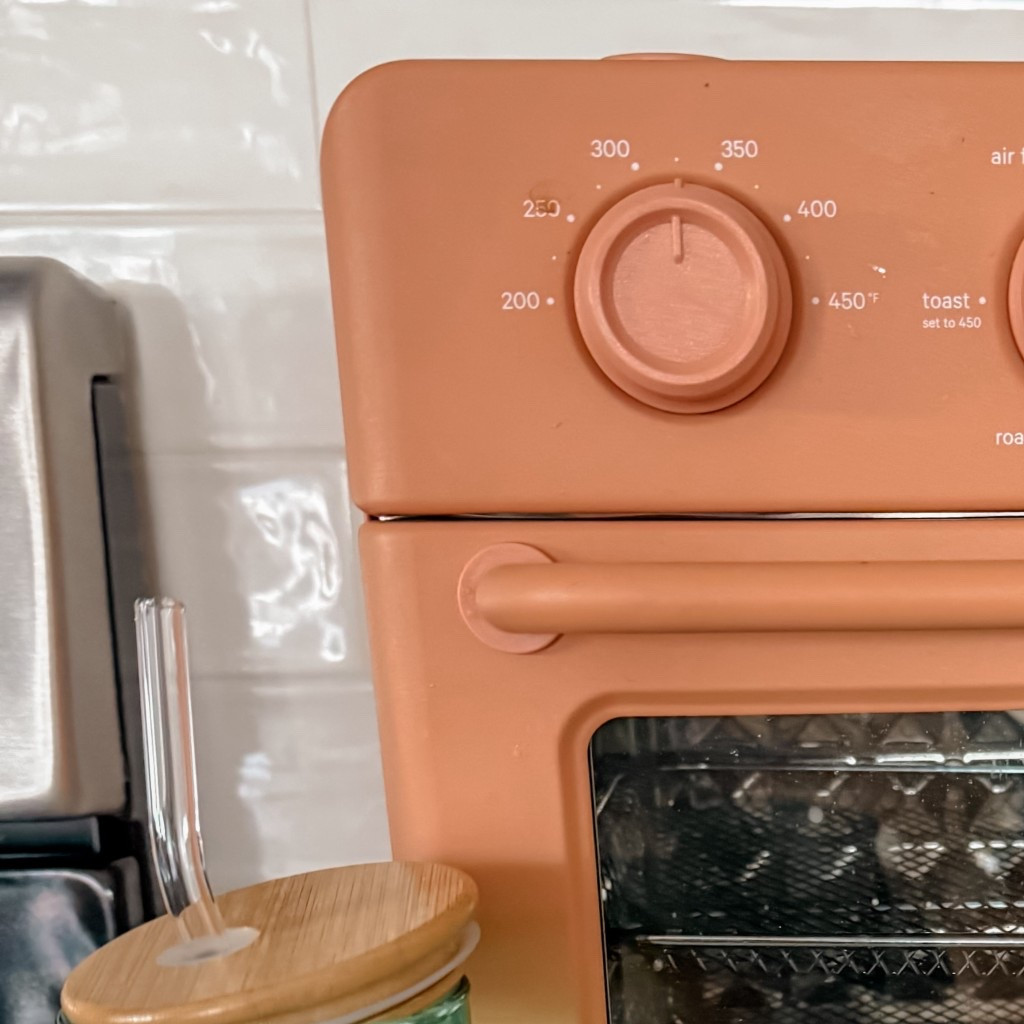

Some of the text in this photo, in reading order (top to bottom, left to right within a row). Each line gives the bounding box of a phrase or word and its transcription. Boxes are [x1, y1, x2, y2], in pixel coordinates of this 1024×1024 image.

[590, 139, 630, 158] 300
[720, 139, 759, 158] 350
[990, 147, 1015, 165] air
[522, 200, 560, 218] 250
[797, 200, 837, 218] 400
[501, 292, 540, 311] 200
[921, 293, 970, 310] toast
[922, 317, 982, 329] set to 450
